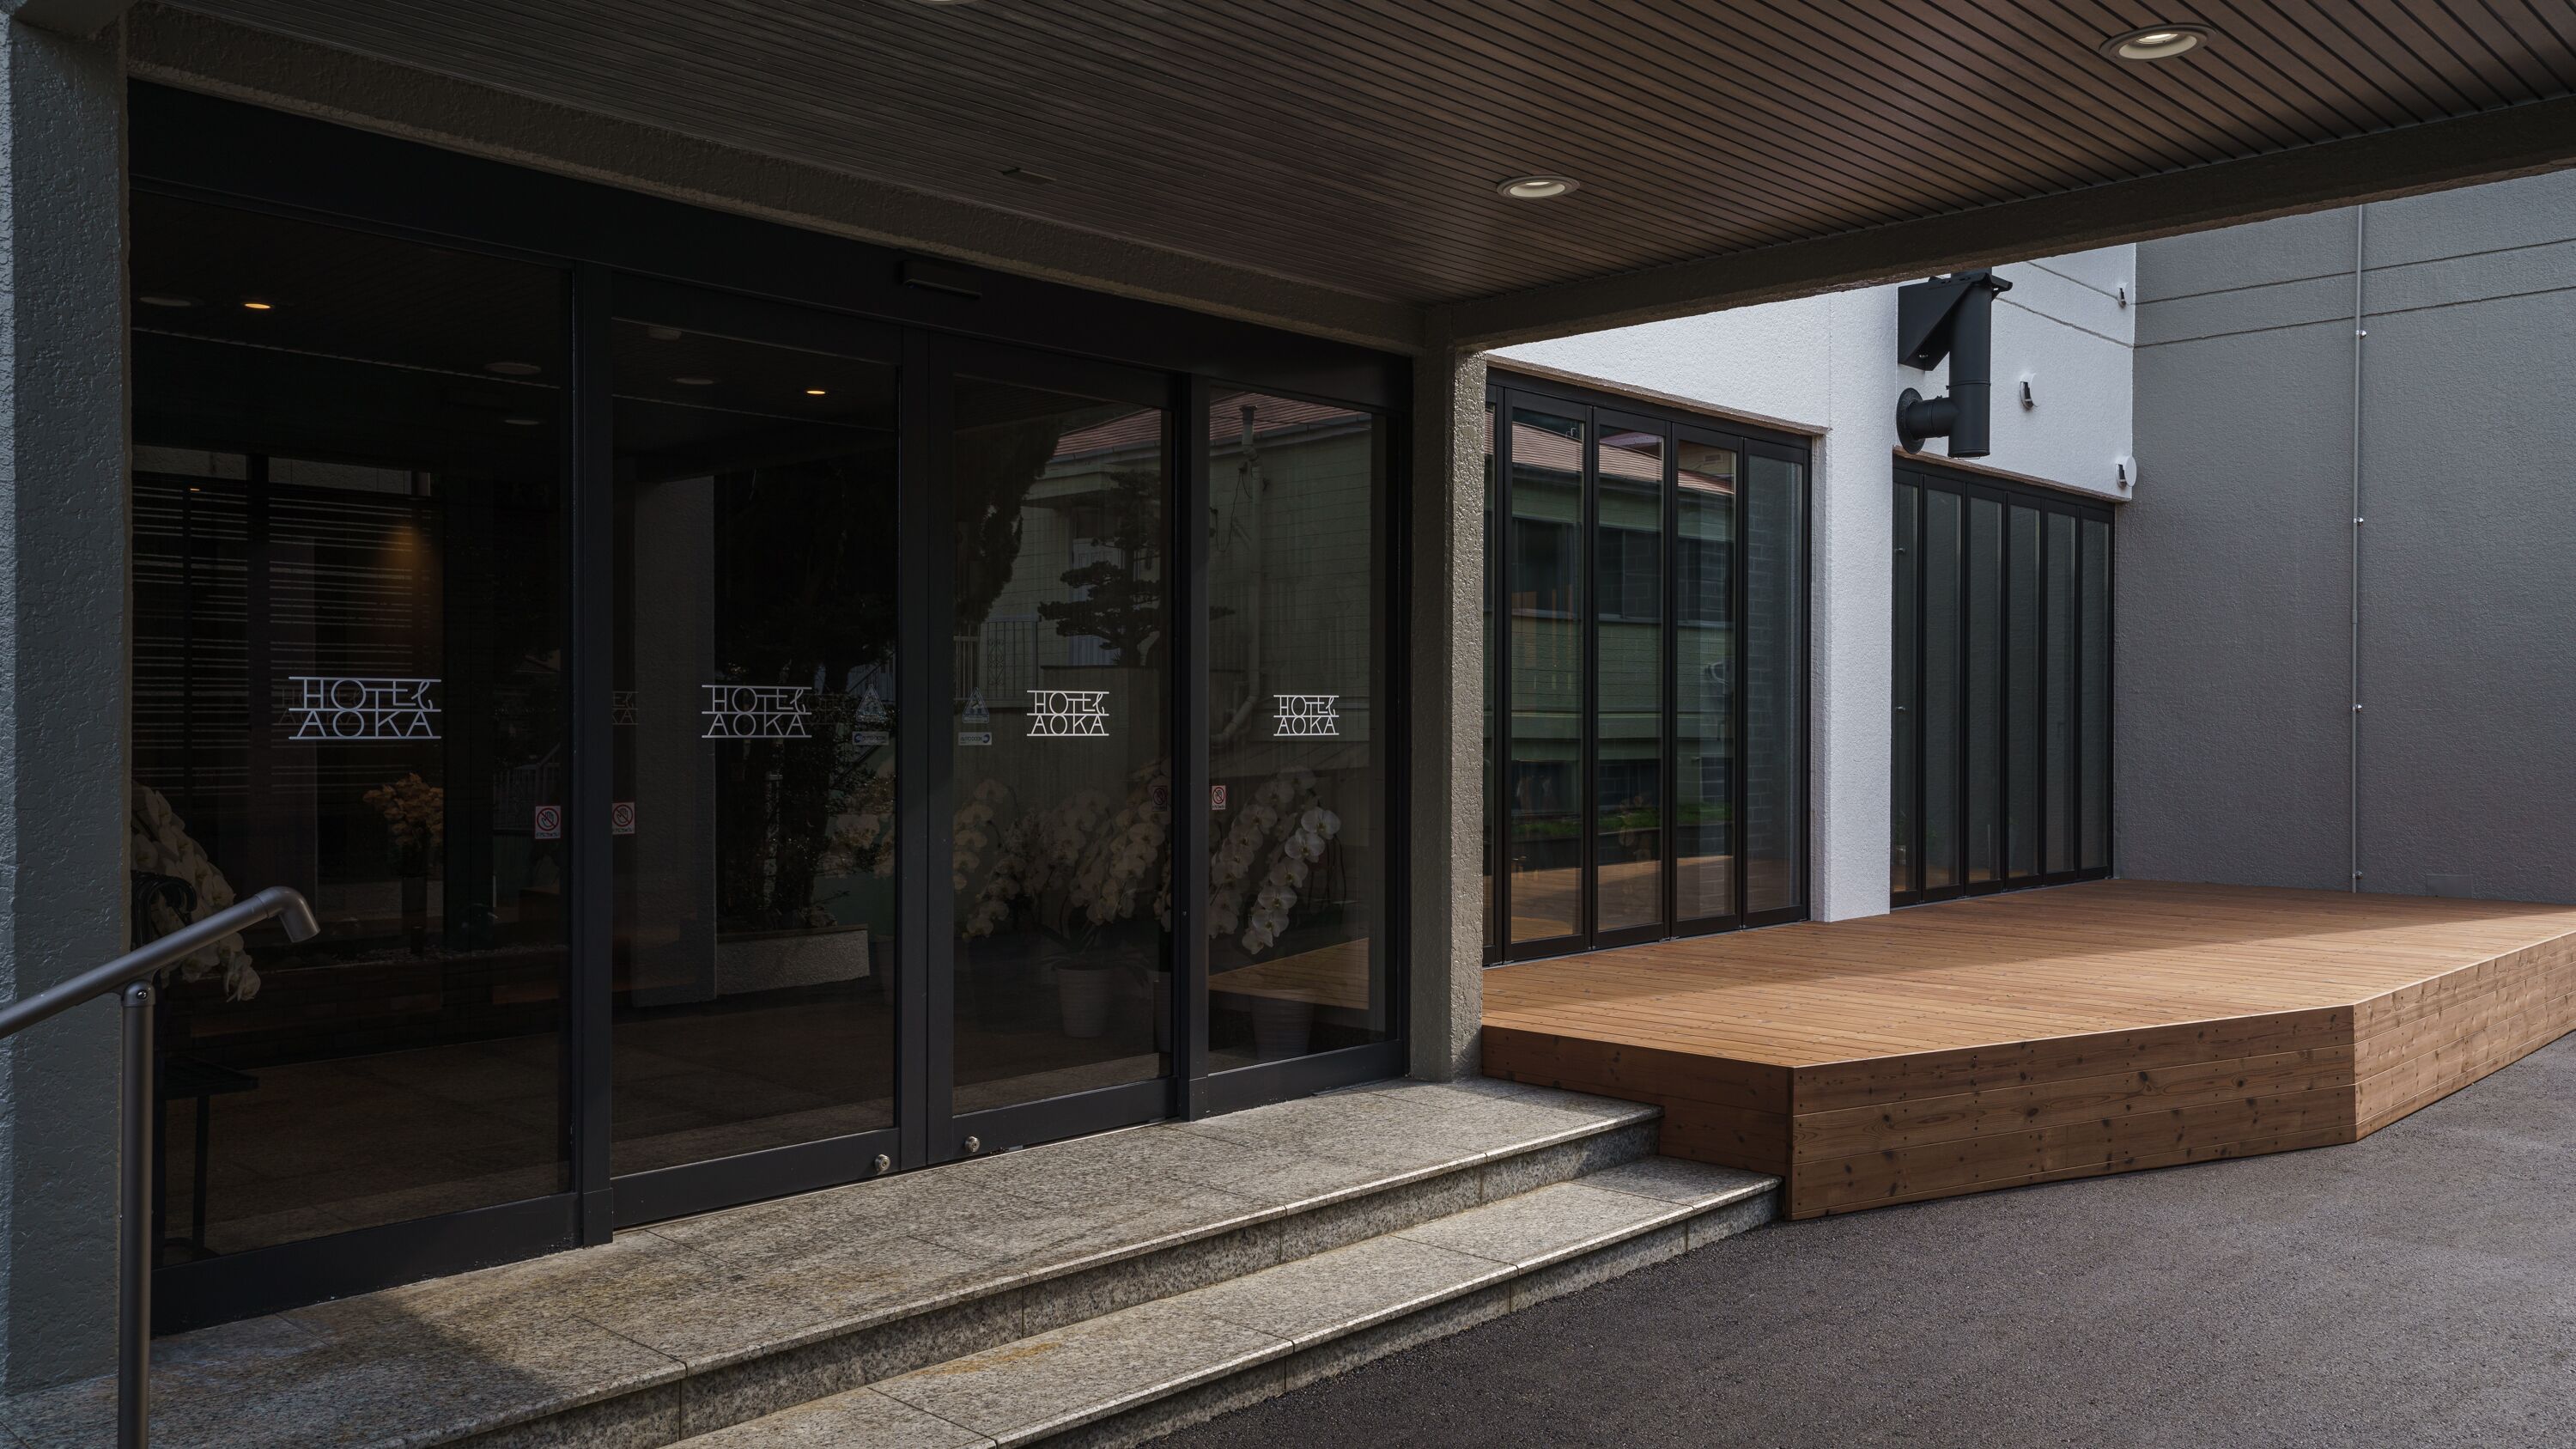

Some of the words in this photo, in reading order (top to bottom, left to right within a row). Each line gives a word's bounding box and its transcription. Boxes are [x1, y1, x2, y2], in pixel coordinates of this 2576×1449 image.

[297, 710, 434, 739] AOKA
[707, 713, 806, 738] AOKA
[1030, 714, 1105, 736] AOKA
[1277, 715, 1336, 736] AOKA
